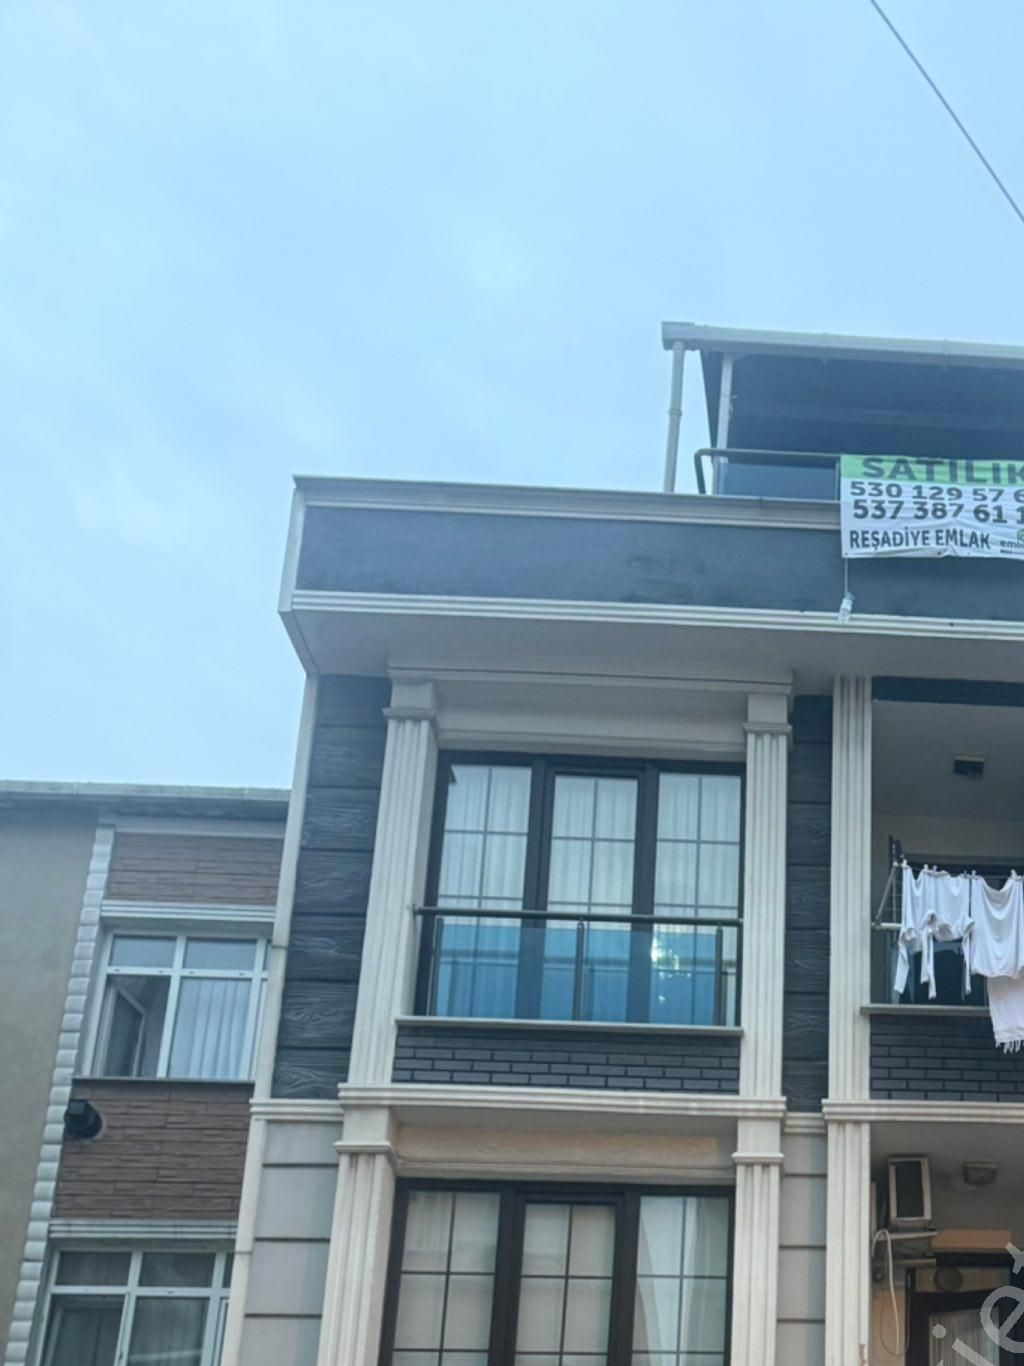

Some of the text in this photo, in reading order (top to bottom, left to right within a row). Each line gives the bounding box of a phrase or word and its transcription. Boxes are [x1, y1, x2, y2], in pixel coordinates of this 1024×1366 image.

[850, 481, 903, 499] 530
[911, 484, 963, 501] 129
[972, 488, 1005, 503] 57
[853, 499, 905, 520] 537
[913, 500, 964, 520] 387
[973, 504, 1008, 524] 61
[850, 526, 991, 551] REŞADİYE EMLAK
